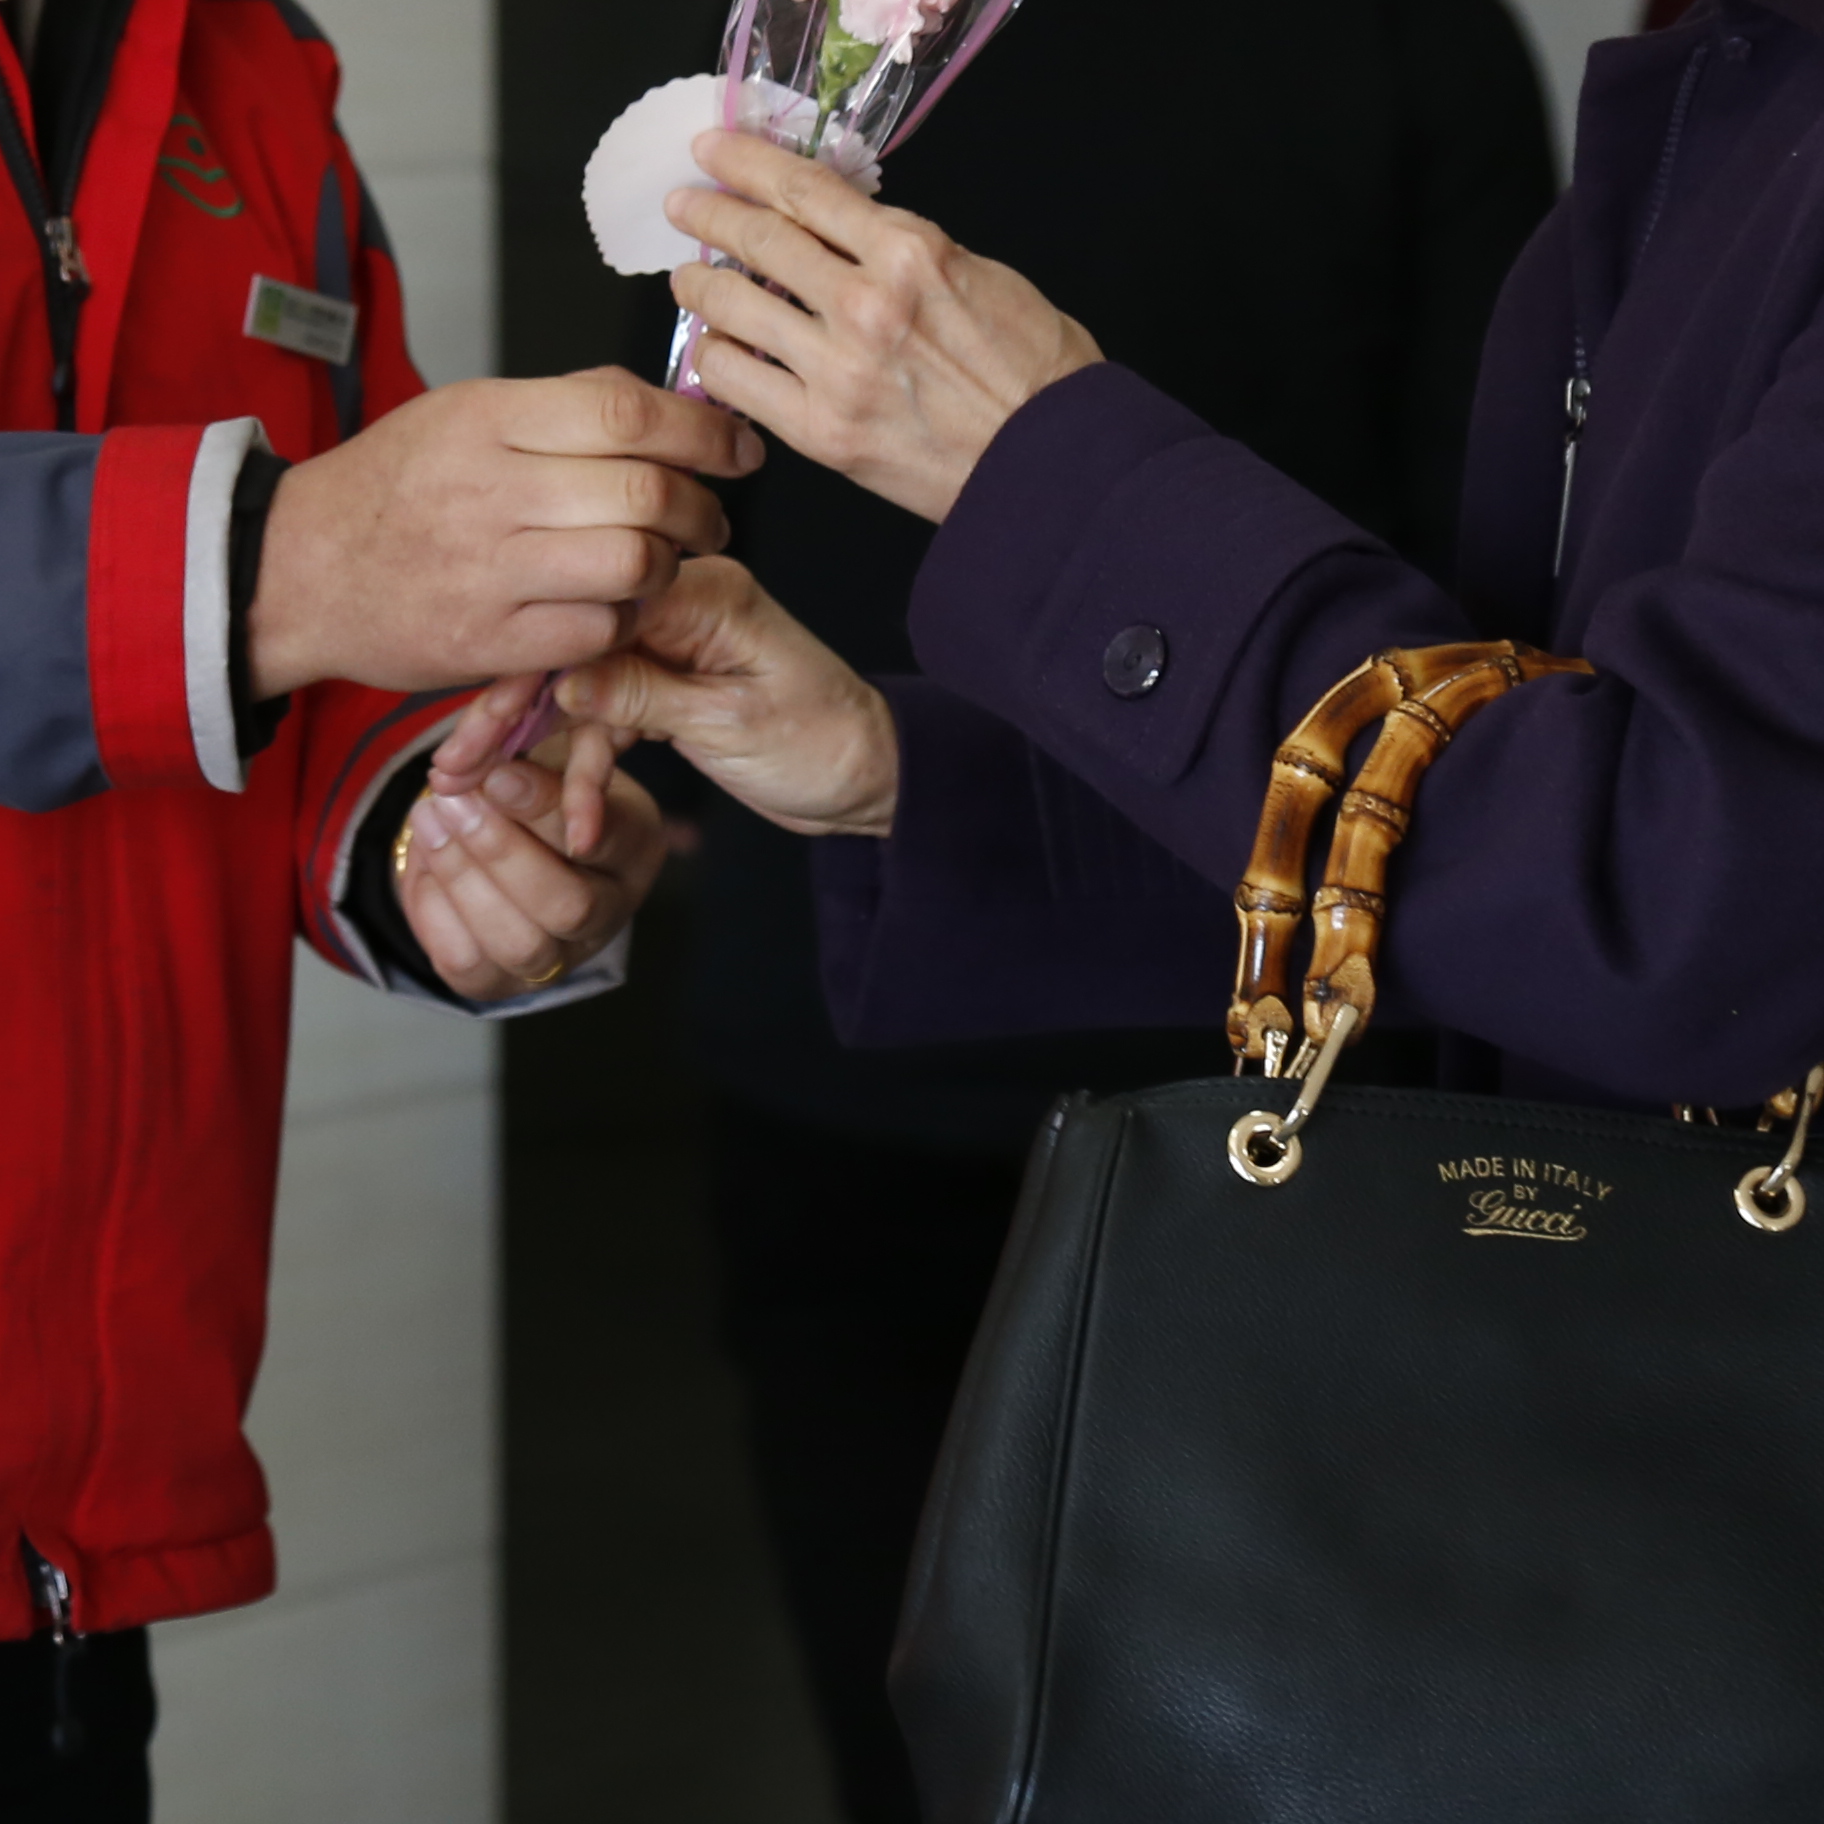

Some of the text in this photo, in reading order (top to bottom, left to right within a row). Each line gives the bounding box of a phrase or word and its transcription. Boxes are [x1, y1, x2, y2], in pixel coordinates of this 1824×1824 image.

[1437, 1156, 1614, 1201] MADE IN ITALY
[1512, 1183, 1539, 1201] BY
[1465, 1189, 1589, 1238] Gucci
